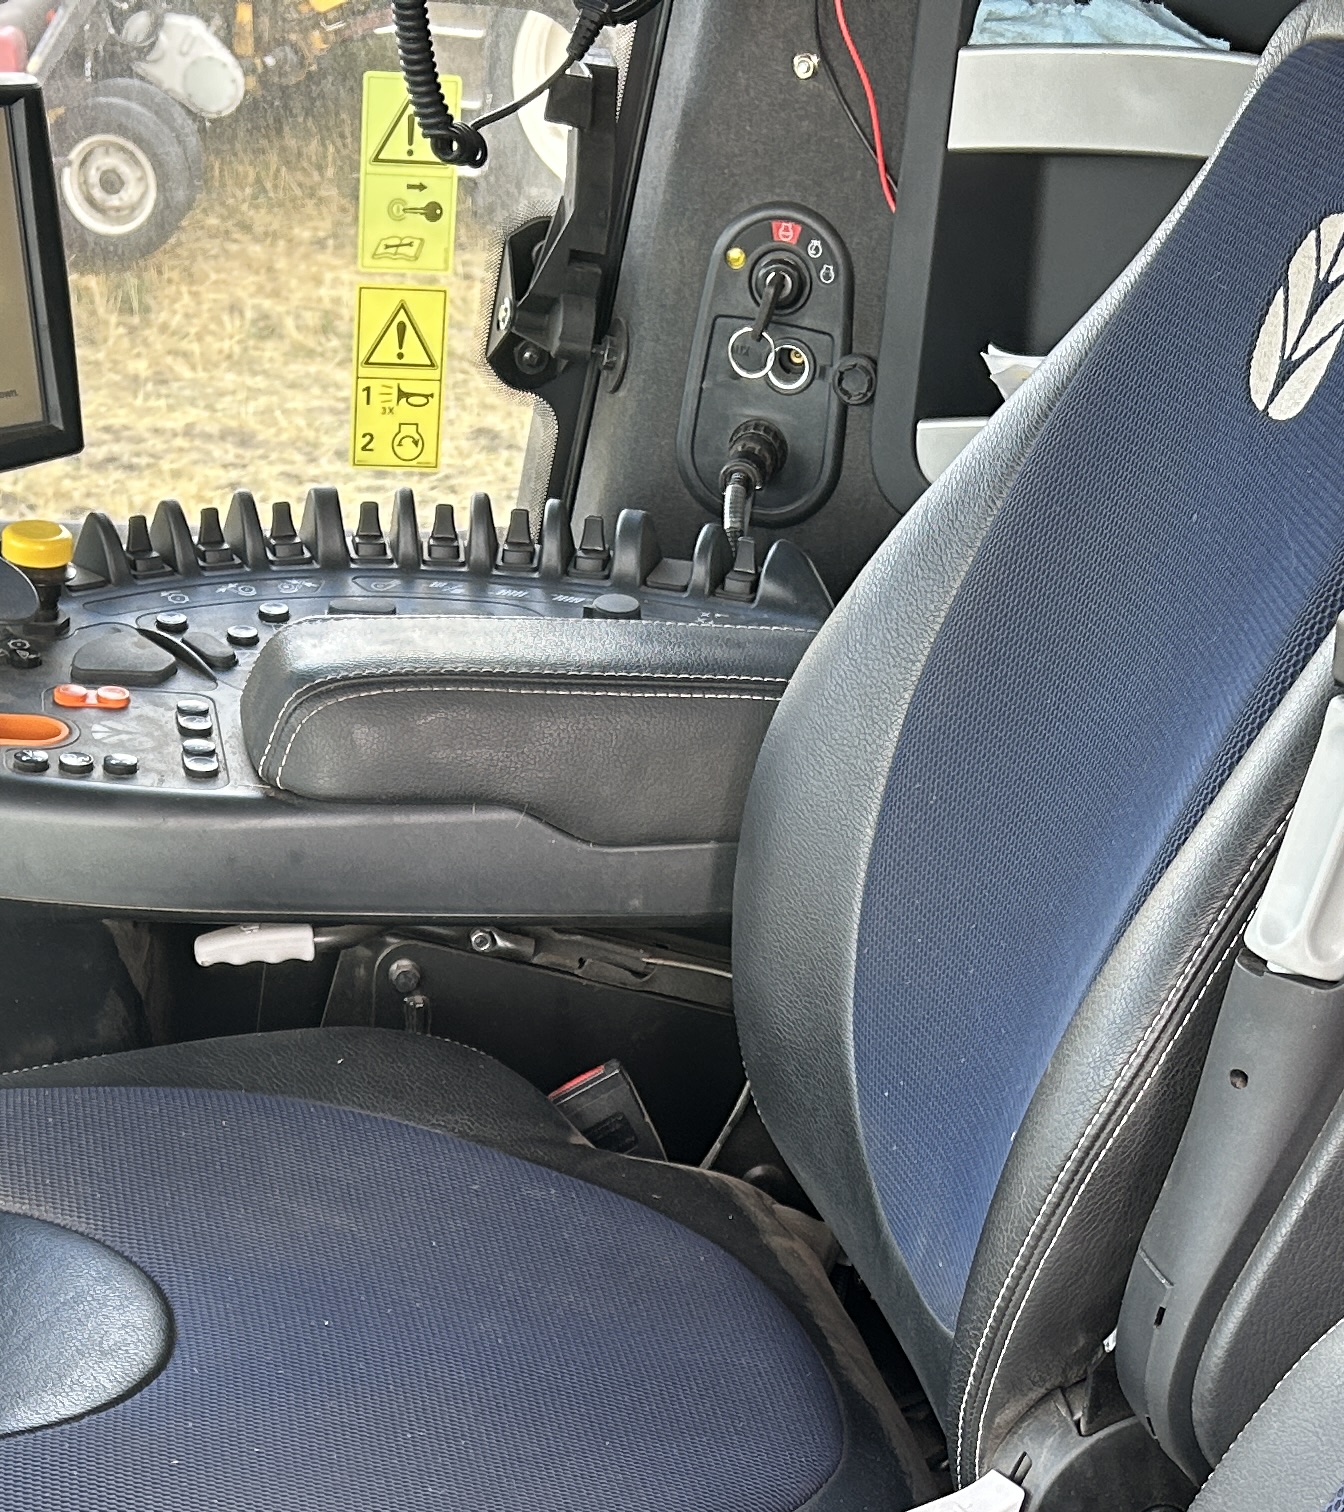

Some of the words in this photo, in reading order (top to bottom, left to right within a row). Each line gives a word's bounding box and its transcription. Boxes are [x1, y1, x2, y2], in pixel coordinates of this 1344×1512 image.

[361, 385, 371, 406] 1
[381, 406, 395, 416] 3X
[360, 432, 375, 452] 2
